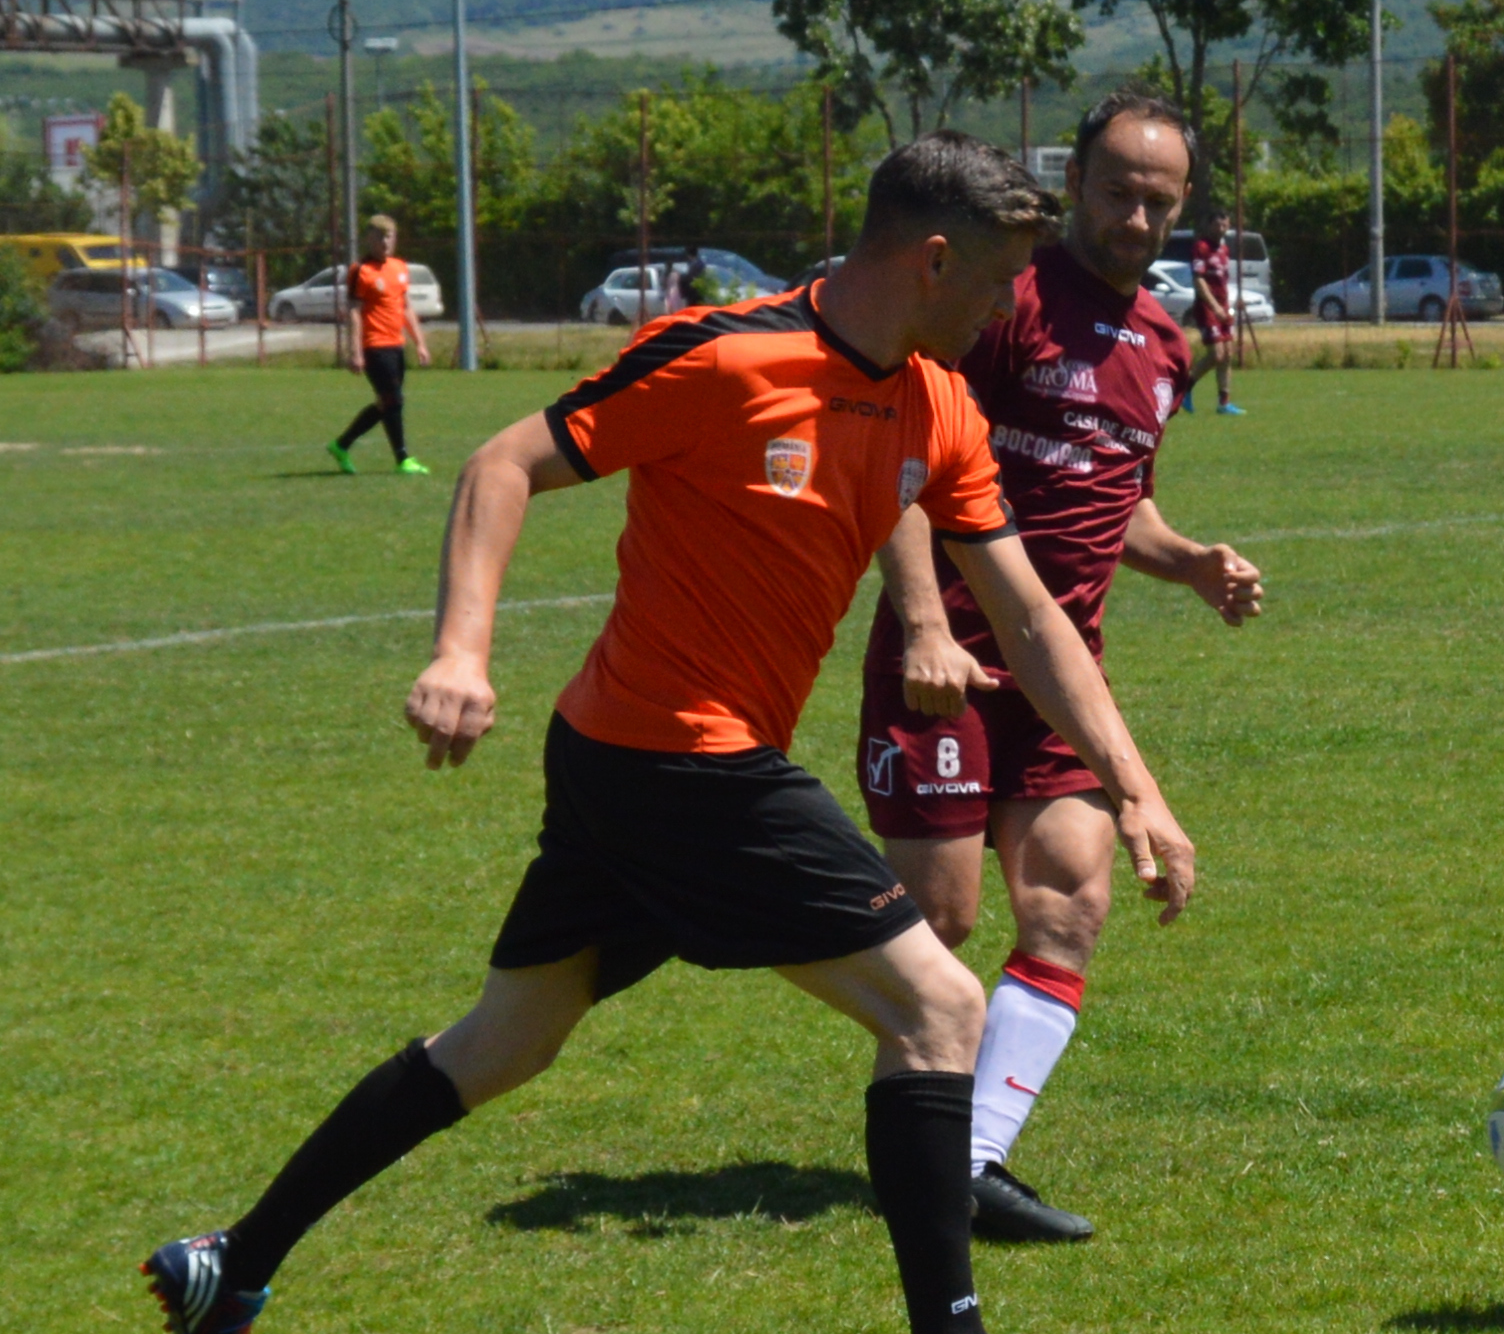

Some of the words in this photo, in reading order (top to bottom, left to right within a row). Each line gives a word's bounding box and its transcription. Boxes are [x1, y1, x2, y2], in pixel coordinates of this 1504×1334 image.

[1094, 322, 1146, 347] GIVOVA
[1021, 364, 1098, 394] AROMA
[937, 737, 961, 778] 8
[916, 782, 981, 795] GIVOVA
